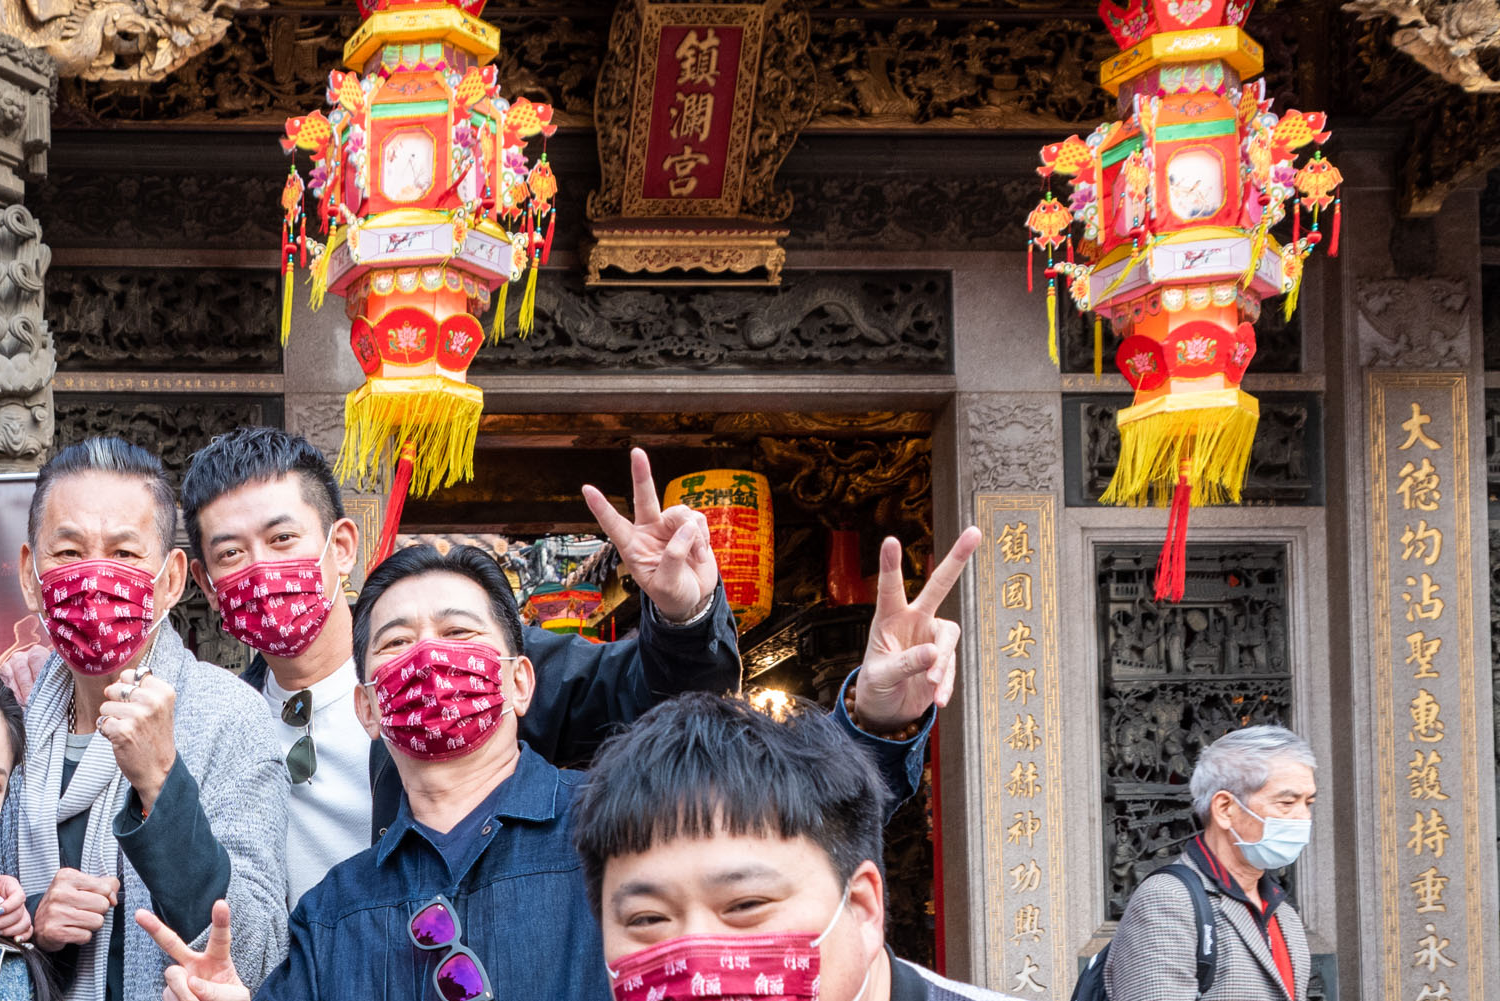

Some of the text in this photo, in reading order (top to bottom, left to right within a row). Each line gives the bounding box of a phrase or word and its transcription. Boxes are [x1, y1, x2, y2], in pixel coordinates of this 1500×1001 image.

[662, 27, 721, 197] 鎮瀾宮
[681, 474, 758, 495] 大甲
[691, 972, 721, 995] 角頭
[755, 972, 784, 995] 角頭
